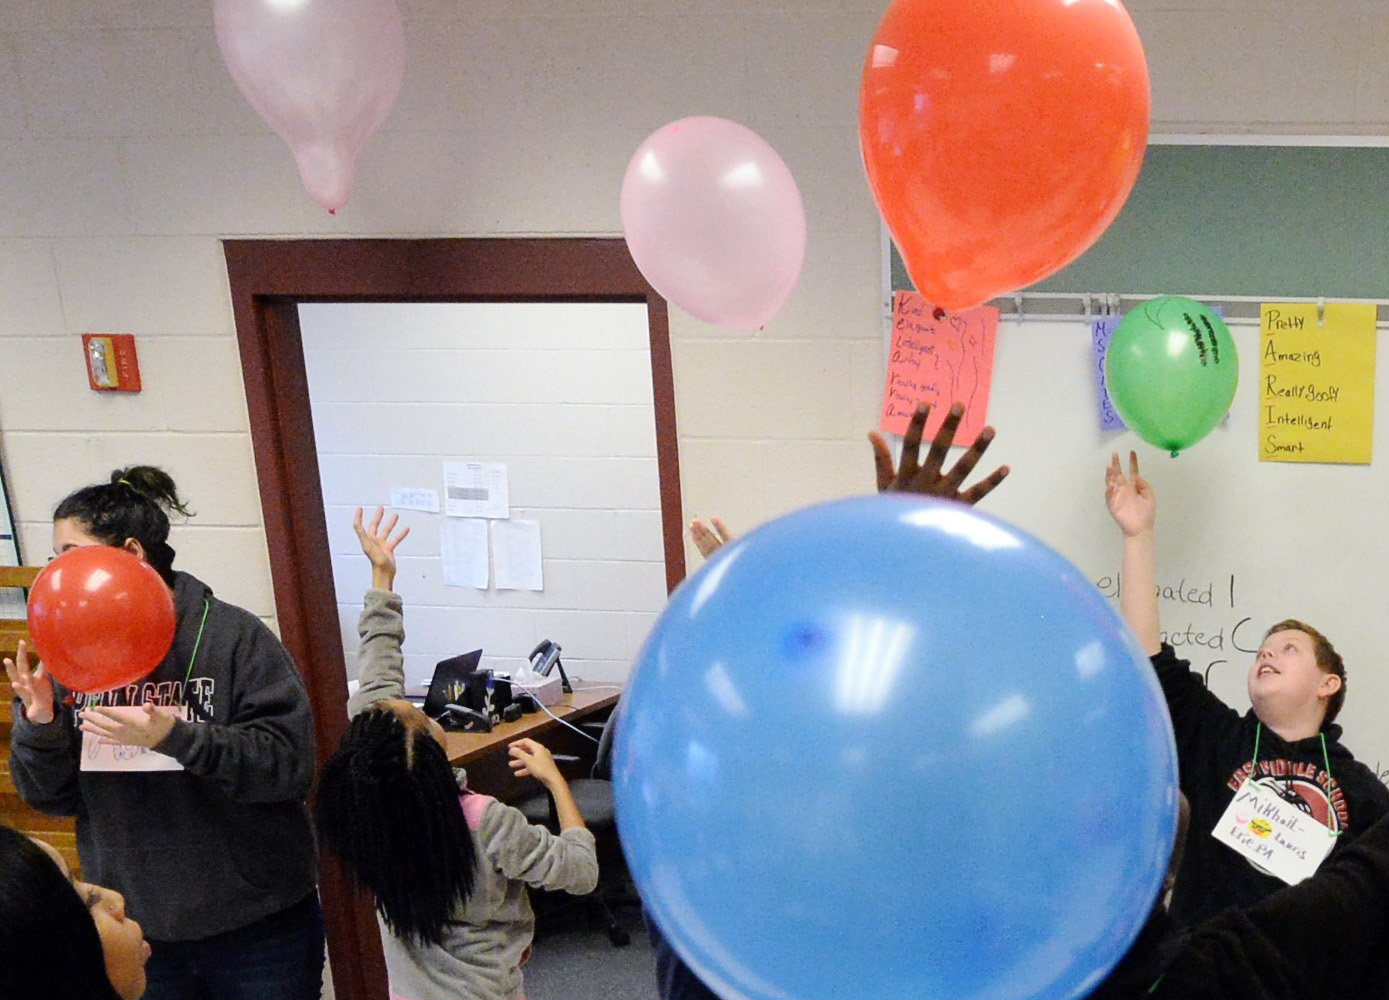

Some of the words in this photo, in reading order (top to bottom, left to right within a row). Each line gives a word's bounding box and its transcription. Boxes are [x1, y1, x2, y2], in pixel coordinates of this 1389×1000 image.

[1265, 310, 1304, 331] Pretty
[1265, 340, 1320, 367] Amazing
[1265, 375, 1305, 397] Really
[1265, 405, 1332, 430] Intelligent
[1265, 435, 1304, 454] Smart
